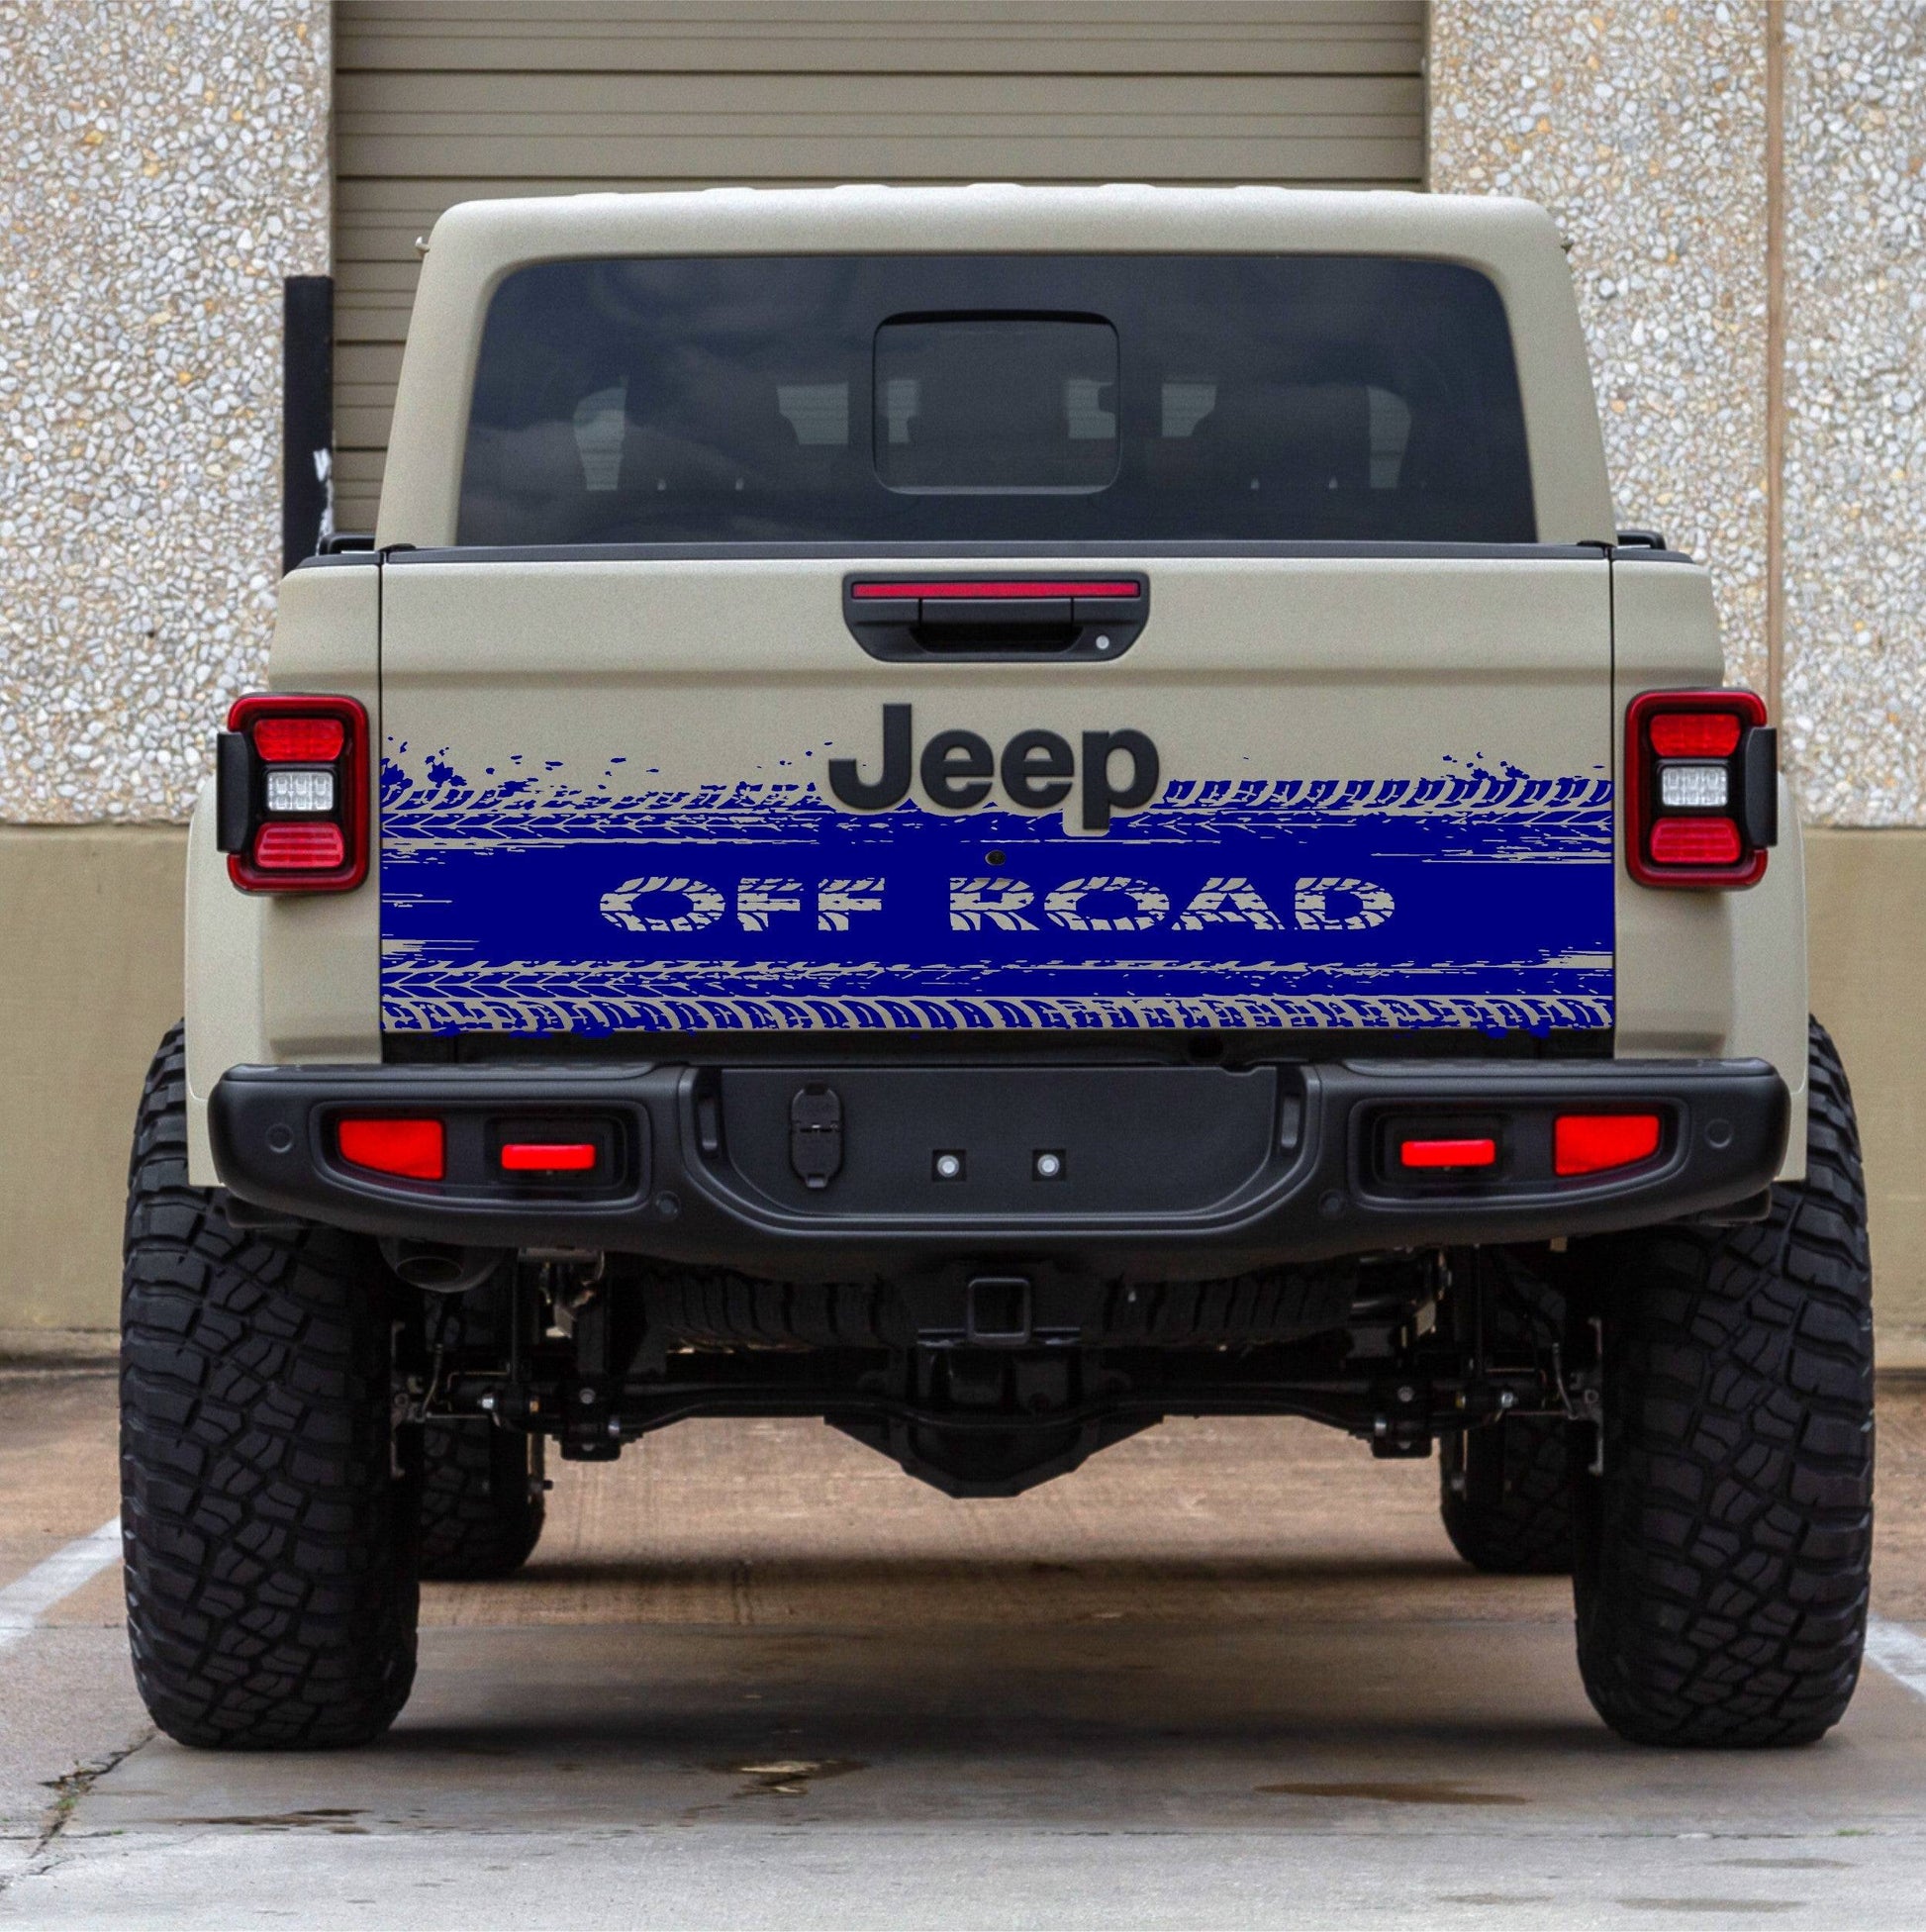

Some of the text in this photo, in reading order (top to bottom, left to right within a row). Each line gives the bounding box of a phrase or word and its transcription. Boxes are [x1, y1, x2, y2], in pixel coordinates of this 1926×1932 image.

[828, 703, 1160, 830] Jeep
[600, 877, 1395, 930] OFF ROAD
